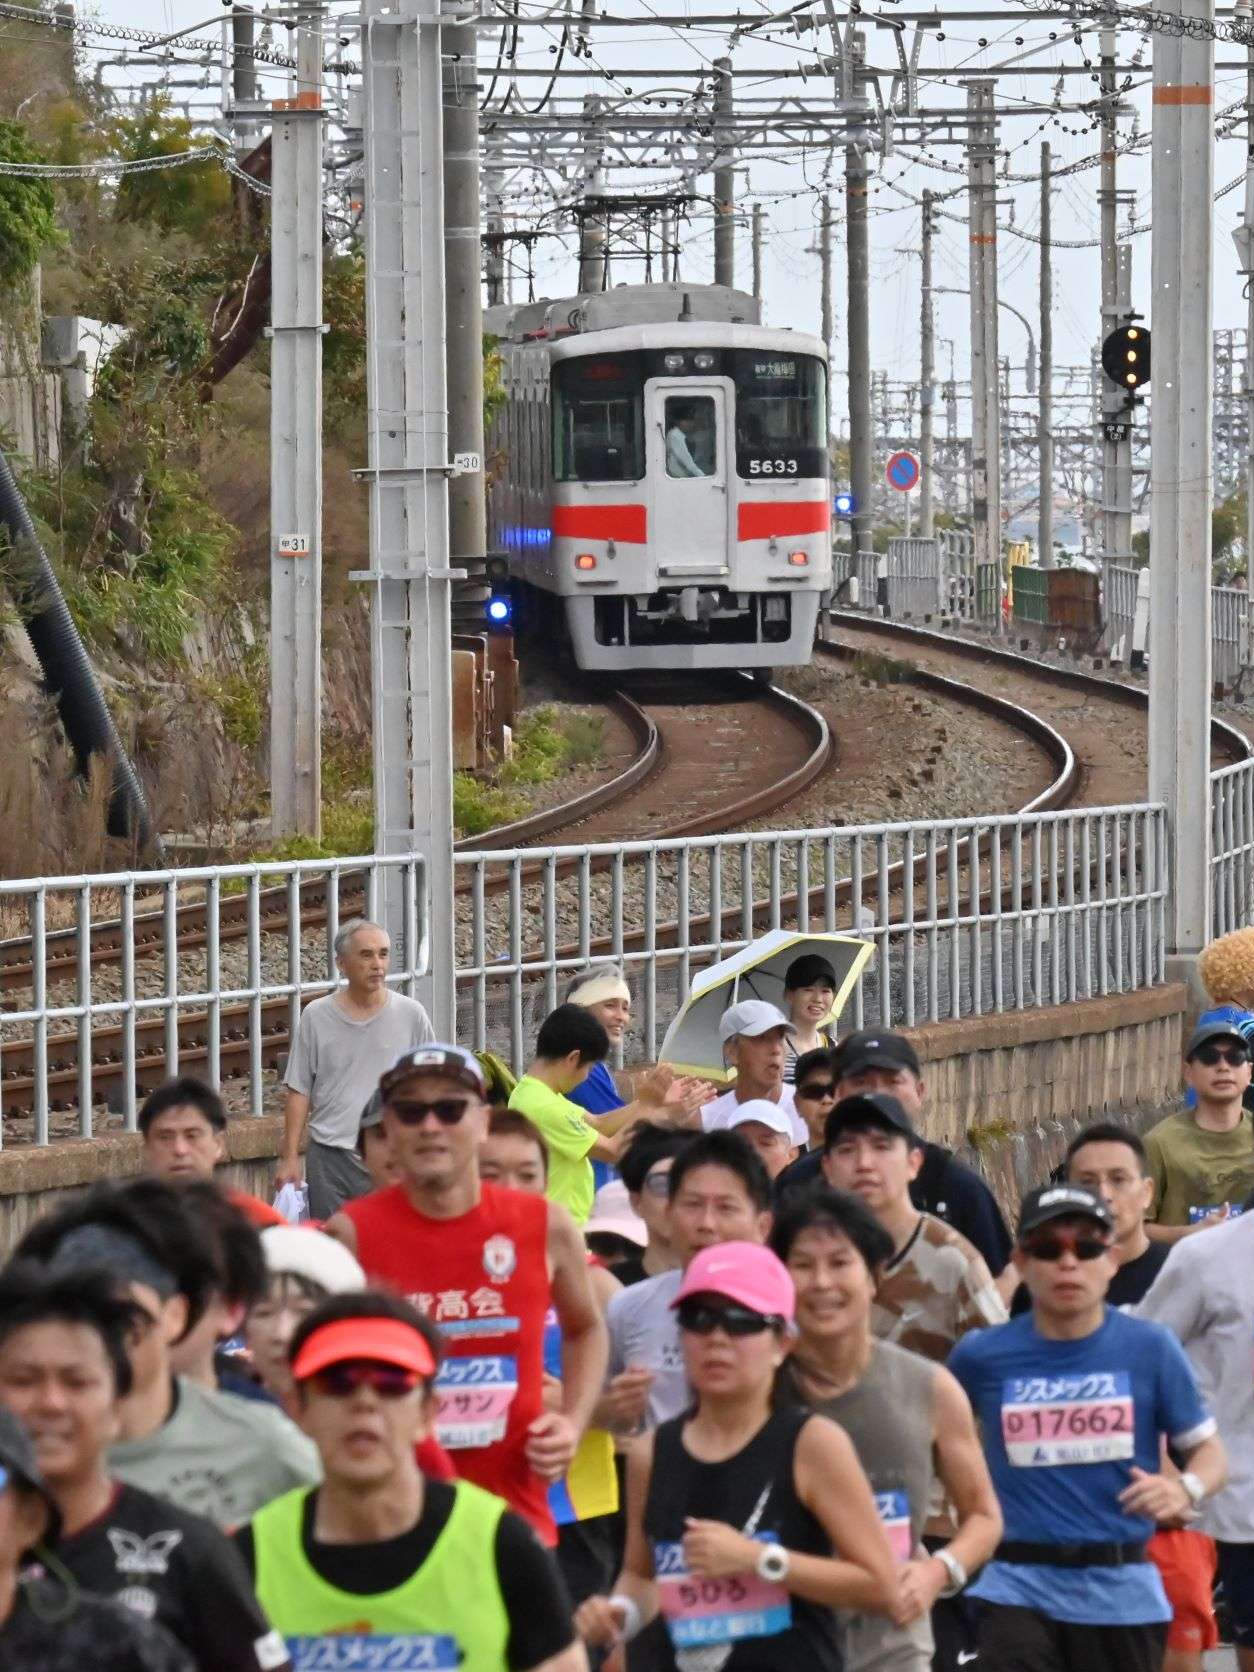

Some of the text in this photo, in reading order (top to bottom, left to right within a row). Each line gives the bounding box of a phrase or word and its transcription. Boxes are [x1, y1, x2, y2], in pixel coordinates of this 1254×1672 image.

[750, 459, 797, 473] 5633
[1014, 1373, 1117, 1402] シスメックス
[295, 1637, 439, 1671] シスメックス
